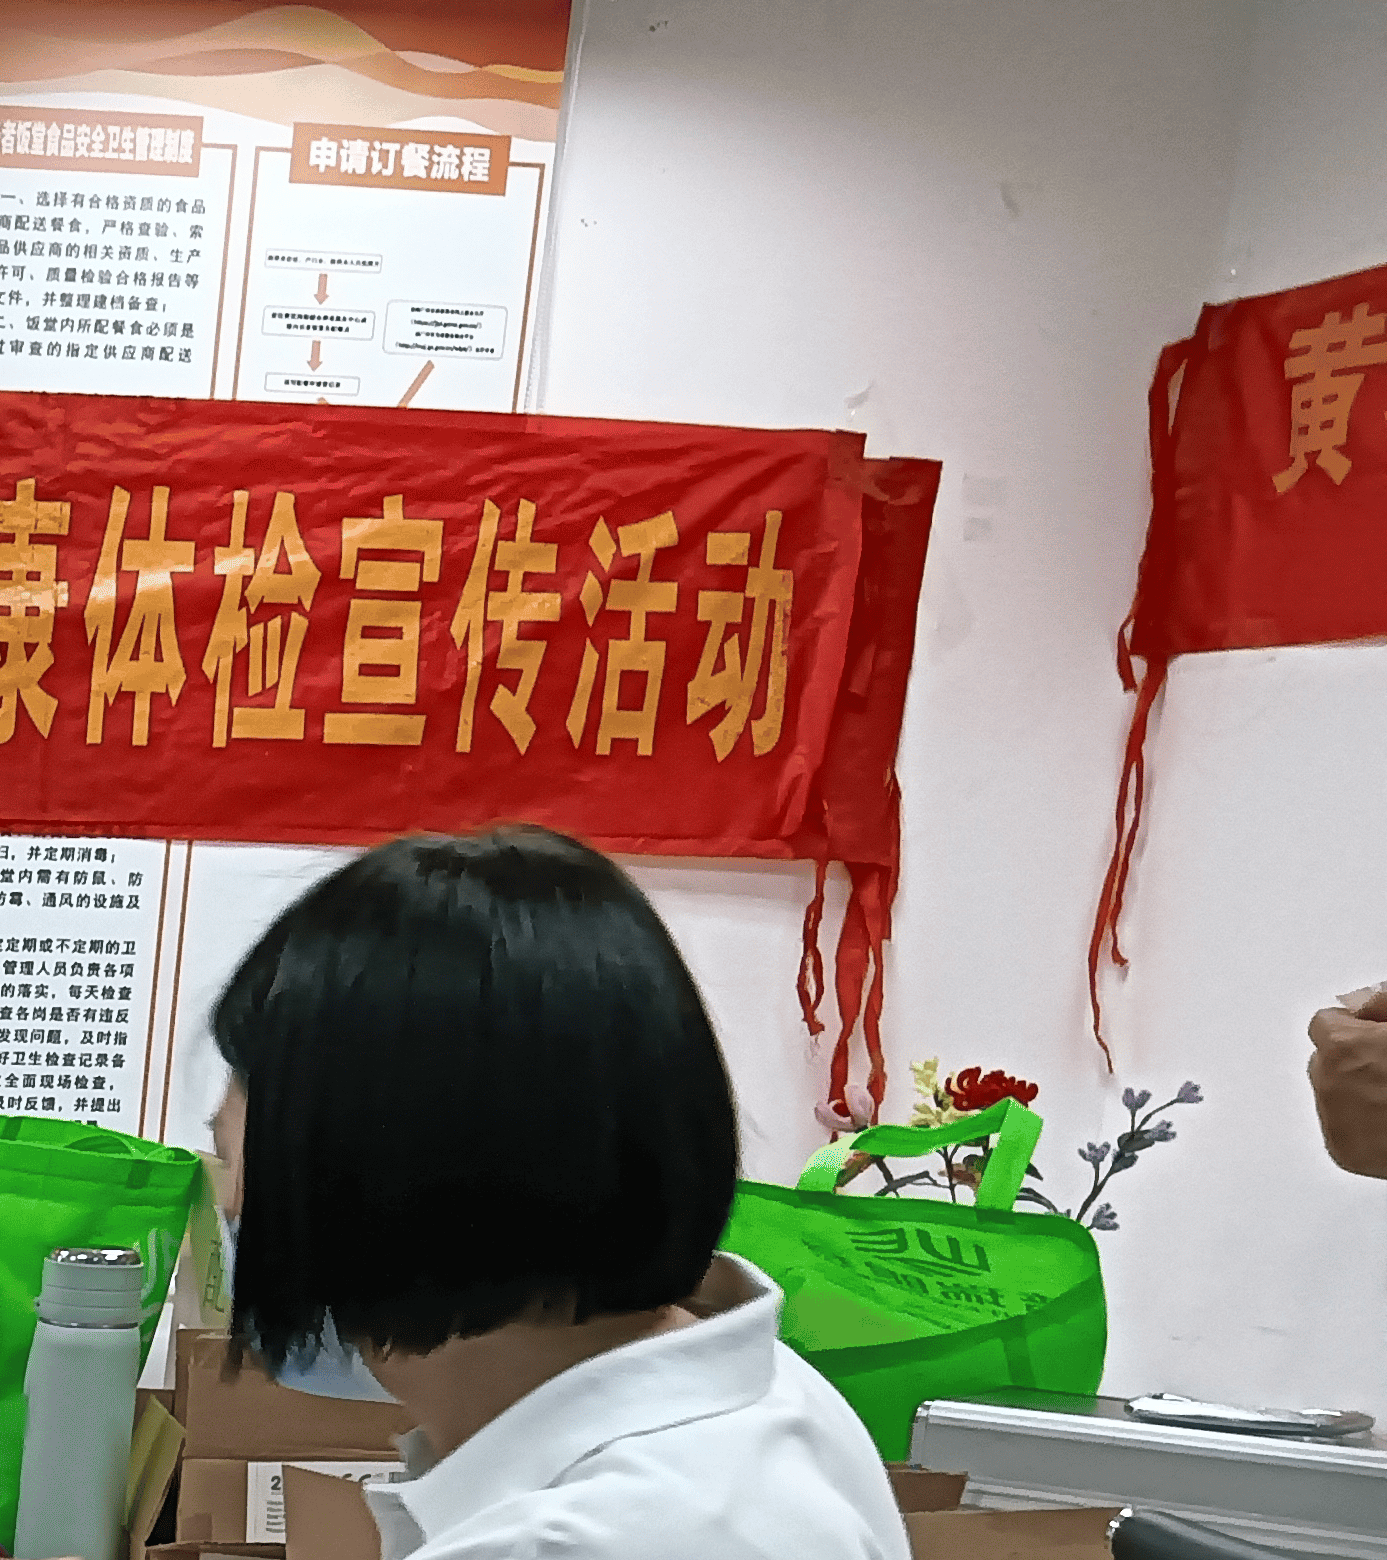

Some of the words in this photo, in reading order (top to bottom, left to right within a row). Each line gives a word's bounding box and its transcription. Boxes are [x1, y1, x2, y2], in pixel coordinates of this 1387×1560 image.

[309, 137, 492, 183] 申请订餐流程
[0, 191, 207, 216] 一、选择有合格资质的食品
[1272, 302, 1387, 494] 黄
